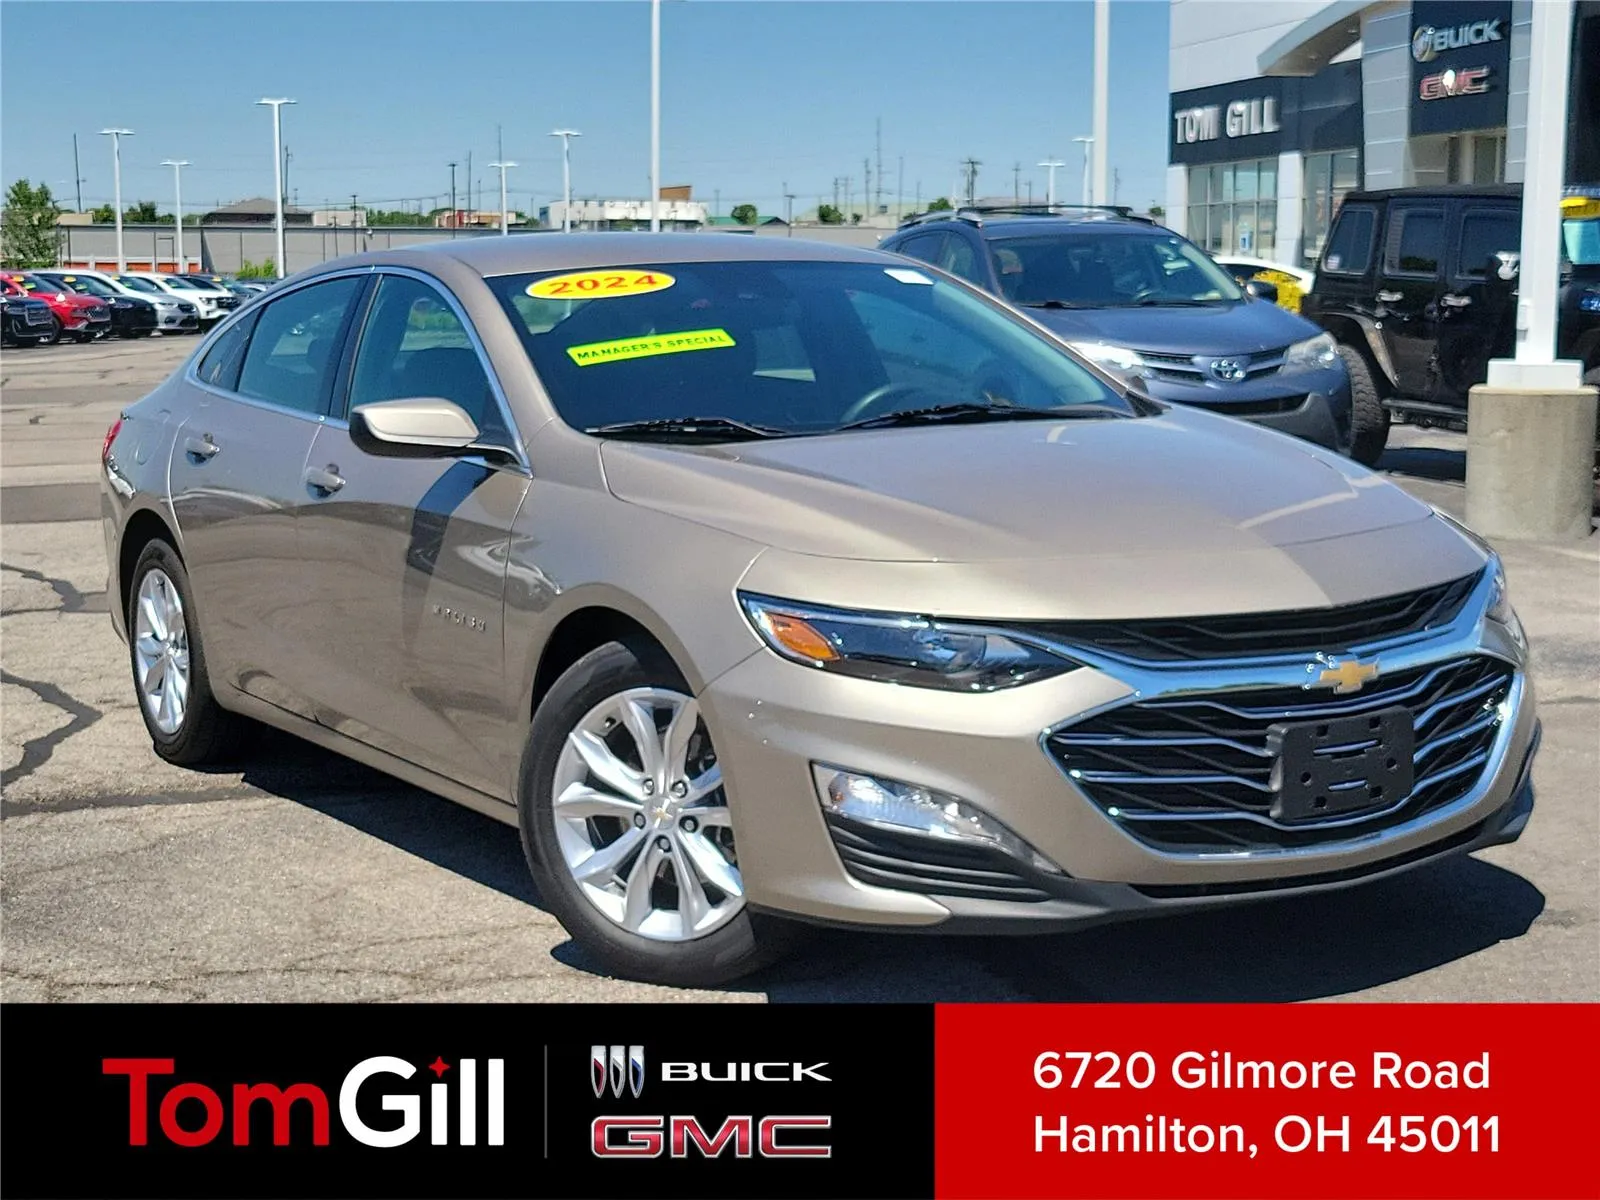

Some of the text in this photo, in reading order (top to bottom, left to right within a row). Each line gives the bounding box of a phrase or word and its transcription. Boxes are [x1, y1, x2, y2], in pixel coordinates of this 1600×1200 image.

[1433, 18, 1502, 51] BUICK
[1174, 96, 1281, 144] TOM GILL
[549, 274, 658, 295] 2024
[577, 335, 726, 359] MANAGER'S SPECIAL
